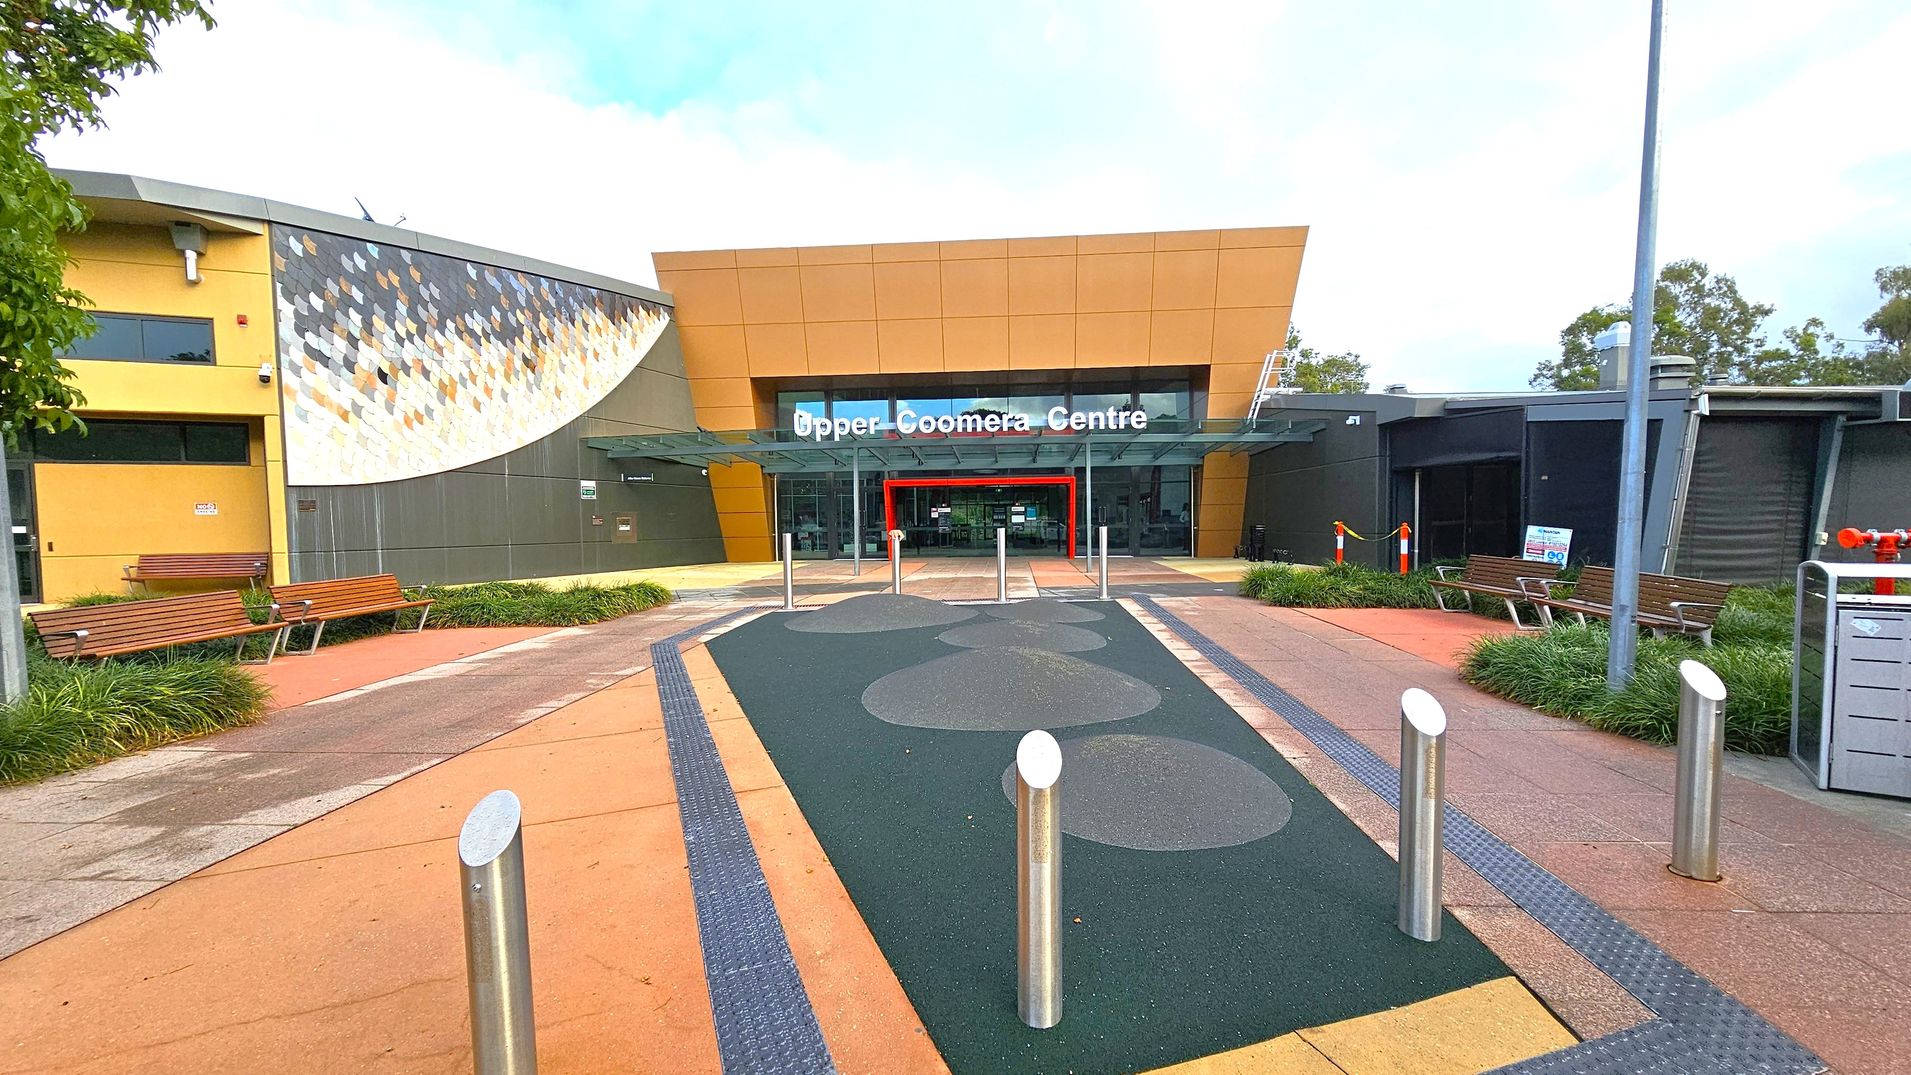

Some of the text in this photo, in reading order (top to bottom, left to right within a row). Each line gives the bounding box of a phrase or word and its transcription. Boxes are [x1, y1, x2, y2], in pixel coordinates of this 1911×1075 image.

[794, 406, 1148, 441] Upper Coomera Centre
